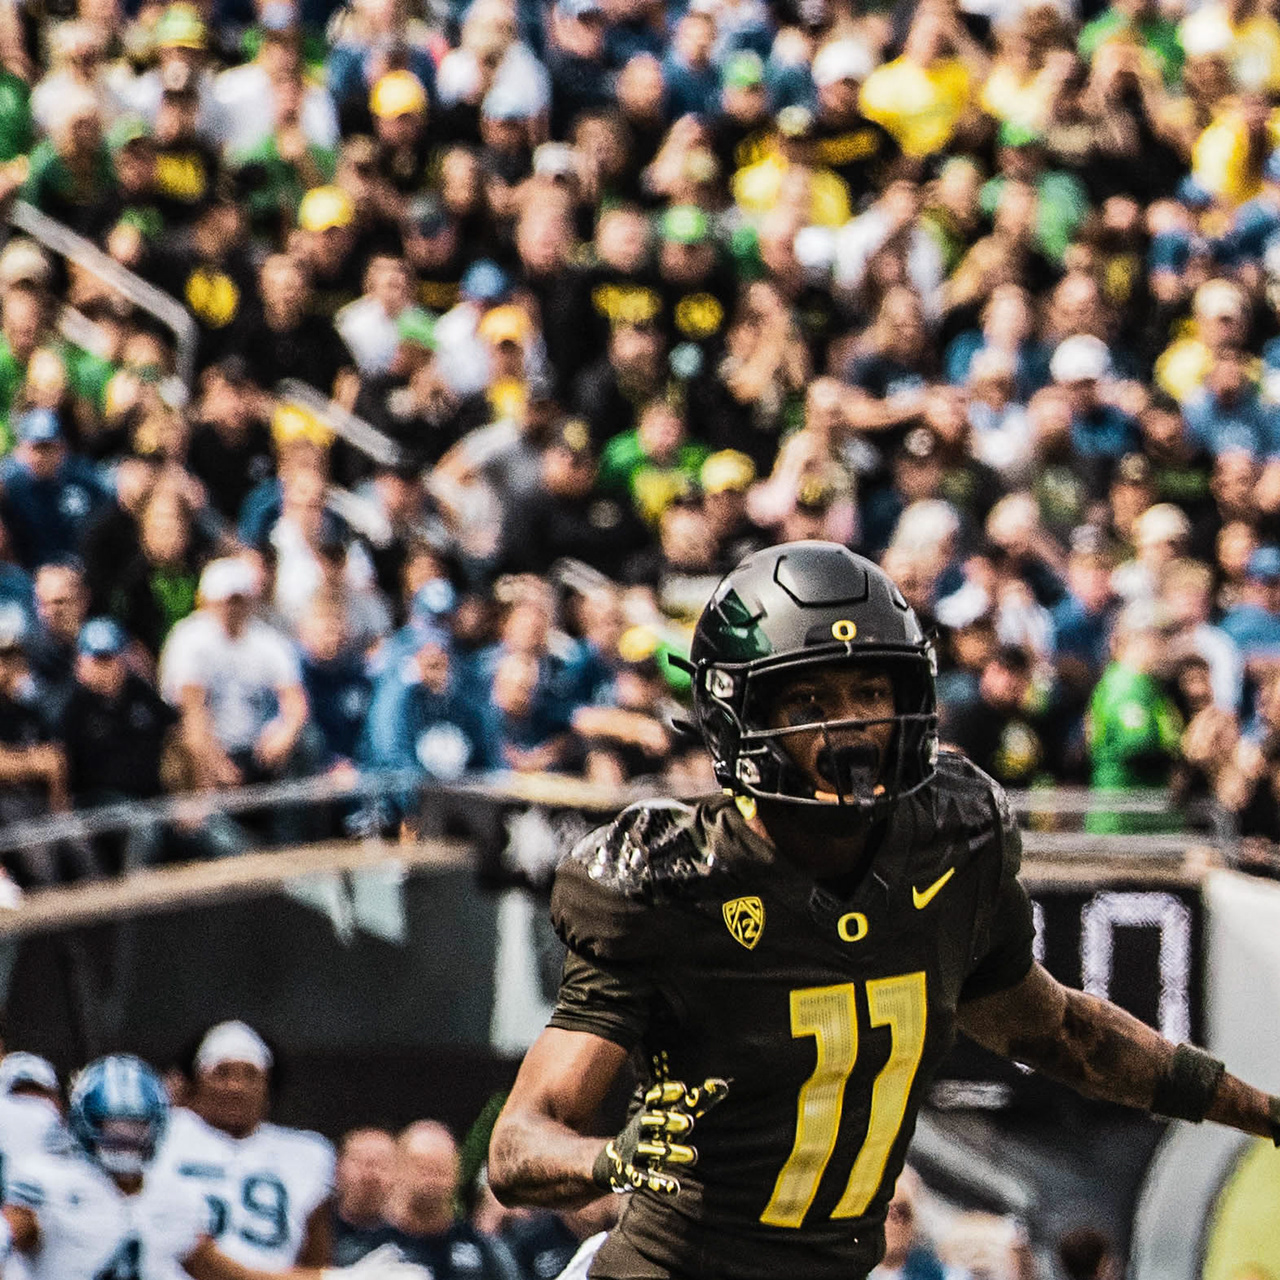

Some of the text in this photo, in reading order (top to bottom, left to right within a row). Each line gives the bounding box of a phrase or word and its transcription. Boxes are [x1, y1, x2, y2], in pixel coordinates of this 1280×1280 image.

[831, 619, 857, 641] O
[837, 912, 869, 942] O
[760, 971, 927, 1228] 11
